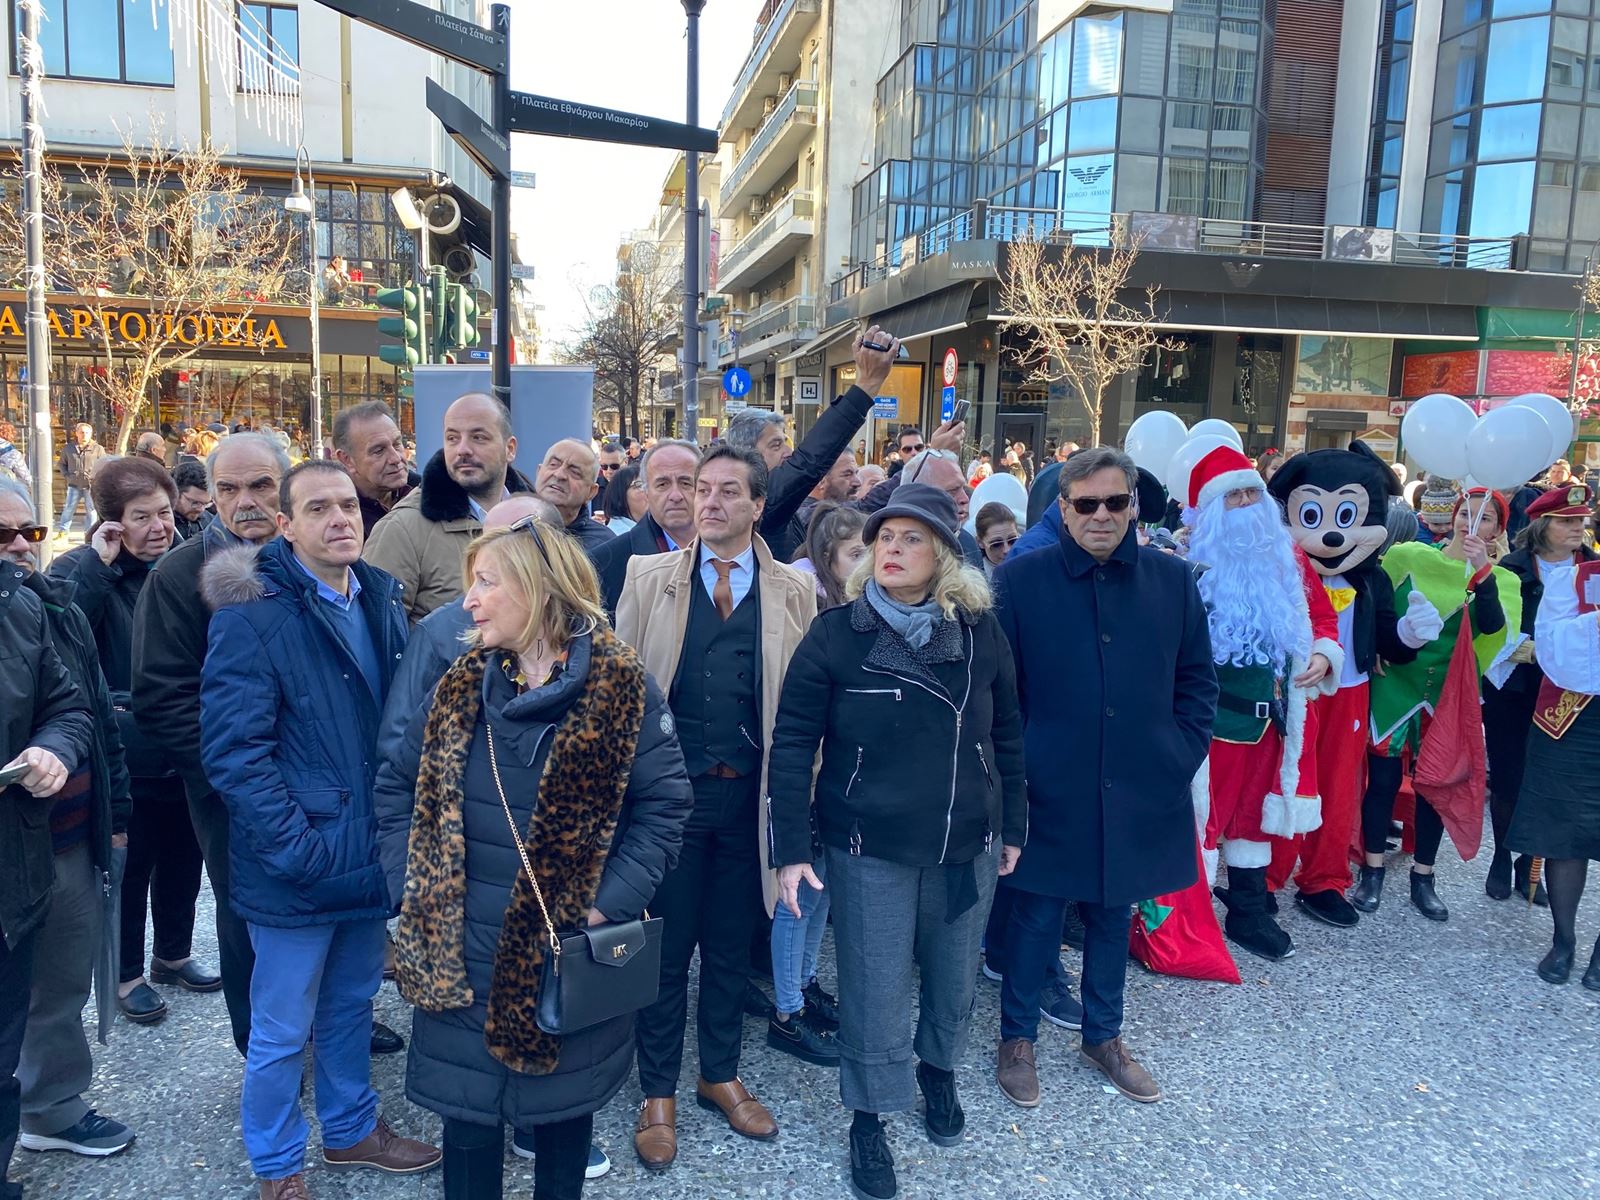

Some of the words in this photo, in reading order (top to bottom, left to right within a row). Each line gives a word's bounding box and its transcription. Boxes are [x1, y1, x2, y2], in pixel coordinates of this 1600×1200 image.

[435, 14, 468, 35] Πλατεία
[469, 27, 494, 44] Σάπκα
[521, 95, 559, 111] Πλατεία
[560, 103, 603, 120] Εθνάρχου
[605, 112, 649, 129] Μακαρίου
